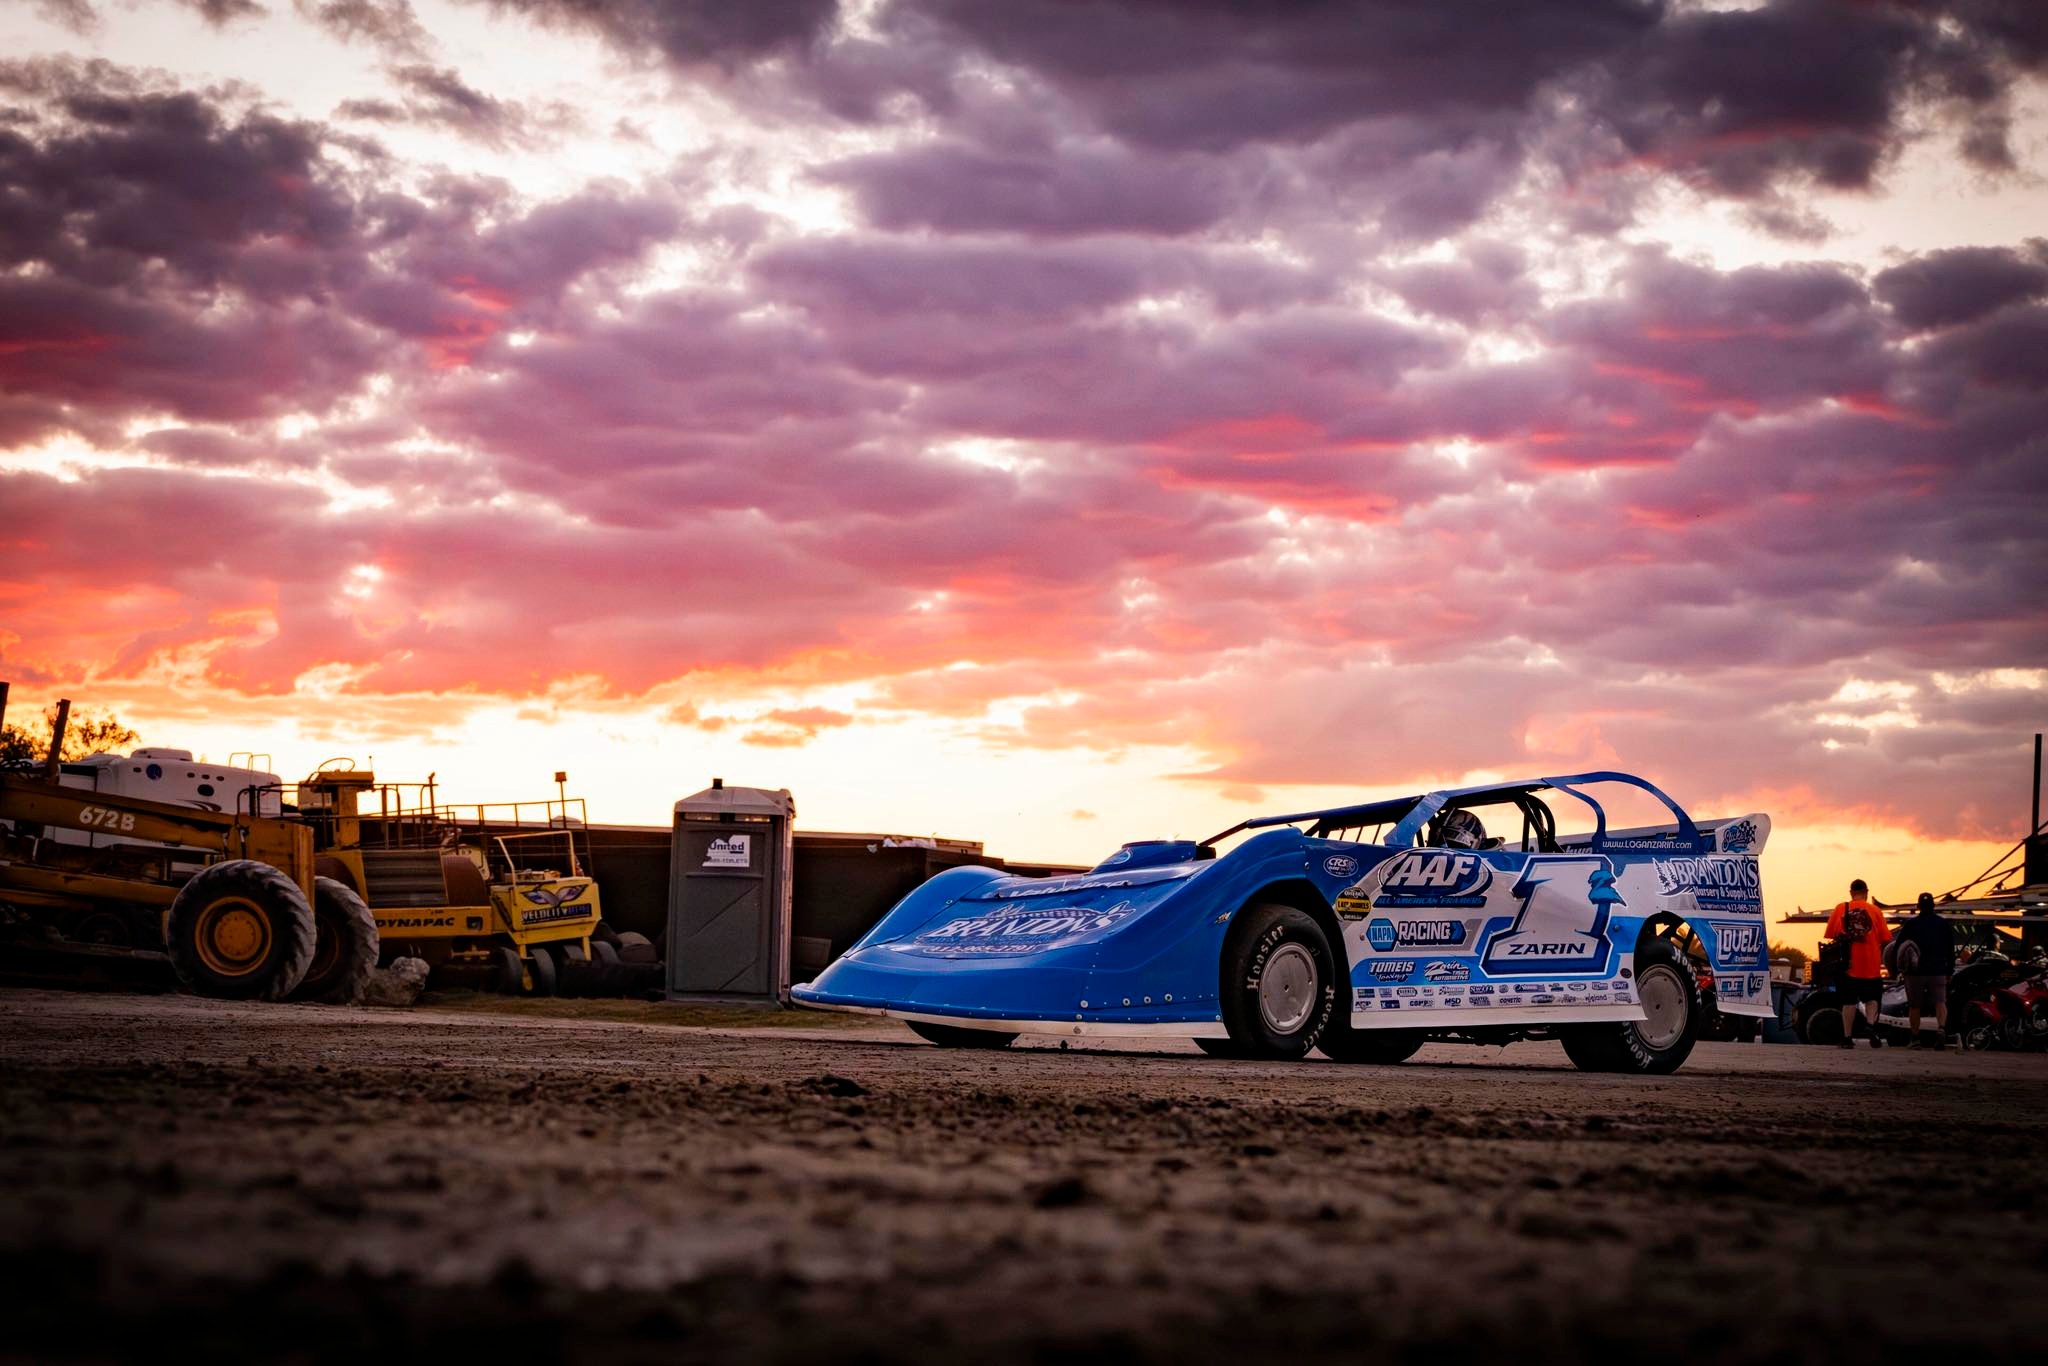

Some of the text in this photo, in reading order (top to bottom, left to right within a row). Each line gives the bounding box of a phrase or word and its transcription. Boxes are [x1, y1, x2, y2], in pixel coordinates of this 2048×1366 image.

[79, 805, 136, 832] 672B
[1602, 838, 1692, 850] www.LOGANZARIN.com
[1386, 854, 1475, 887] AAF
[1671, 856, 1760, 889] BRANDON'S
[1692, 886, 1719, 900] Nursery
[375, 917, 455, 928] DYNAPAC
[1369, 921, 1451, 944] NAPA RACING
[1246, 925, 1285, 991] Hoosier
[1507, 943, 1585, 955] ZARIN
[1621, 1022, 1654, 1069] Hoosi
